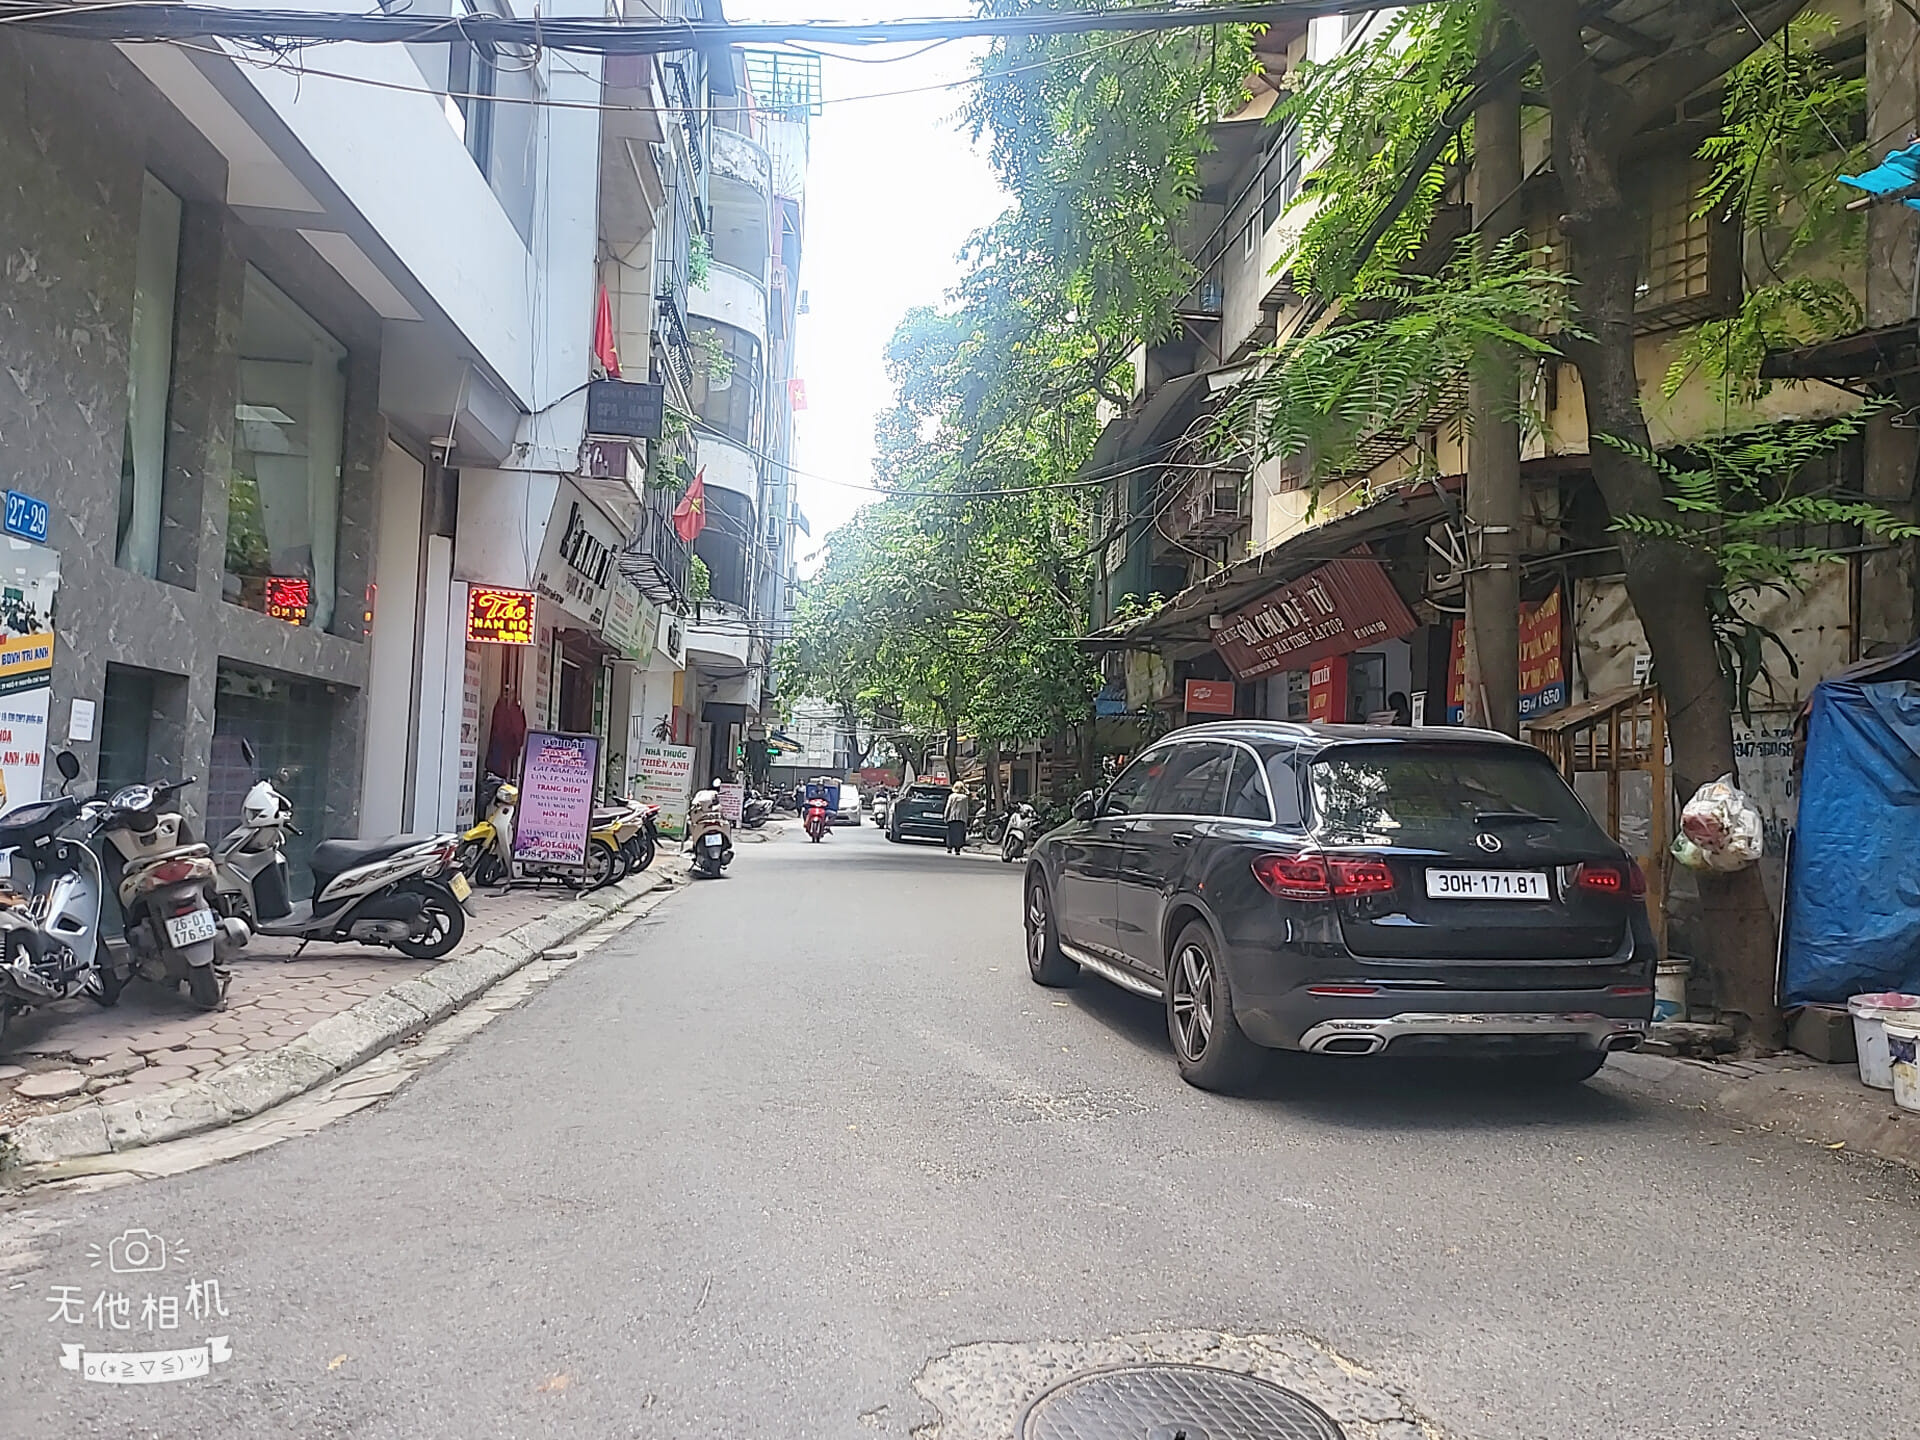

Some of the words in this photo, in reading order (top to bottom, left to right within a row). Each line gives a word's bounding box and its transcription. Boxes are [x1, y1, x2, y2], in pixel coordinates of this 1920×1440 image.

[8, 496, 46, 535] 27-29
[670, 761, 690, 770] ANH
[1440, 875, 1537, 894] 30H-171.81
[174, 924, 214, 945] 176.59
